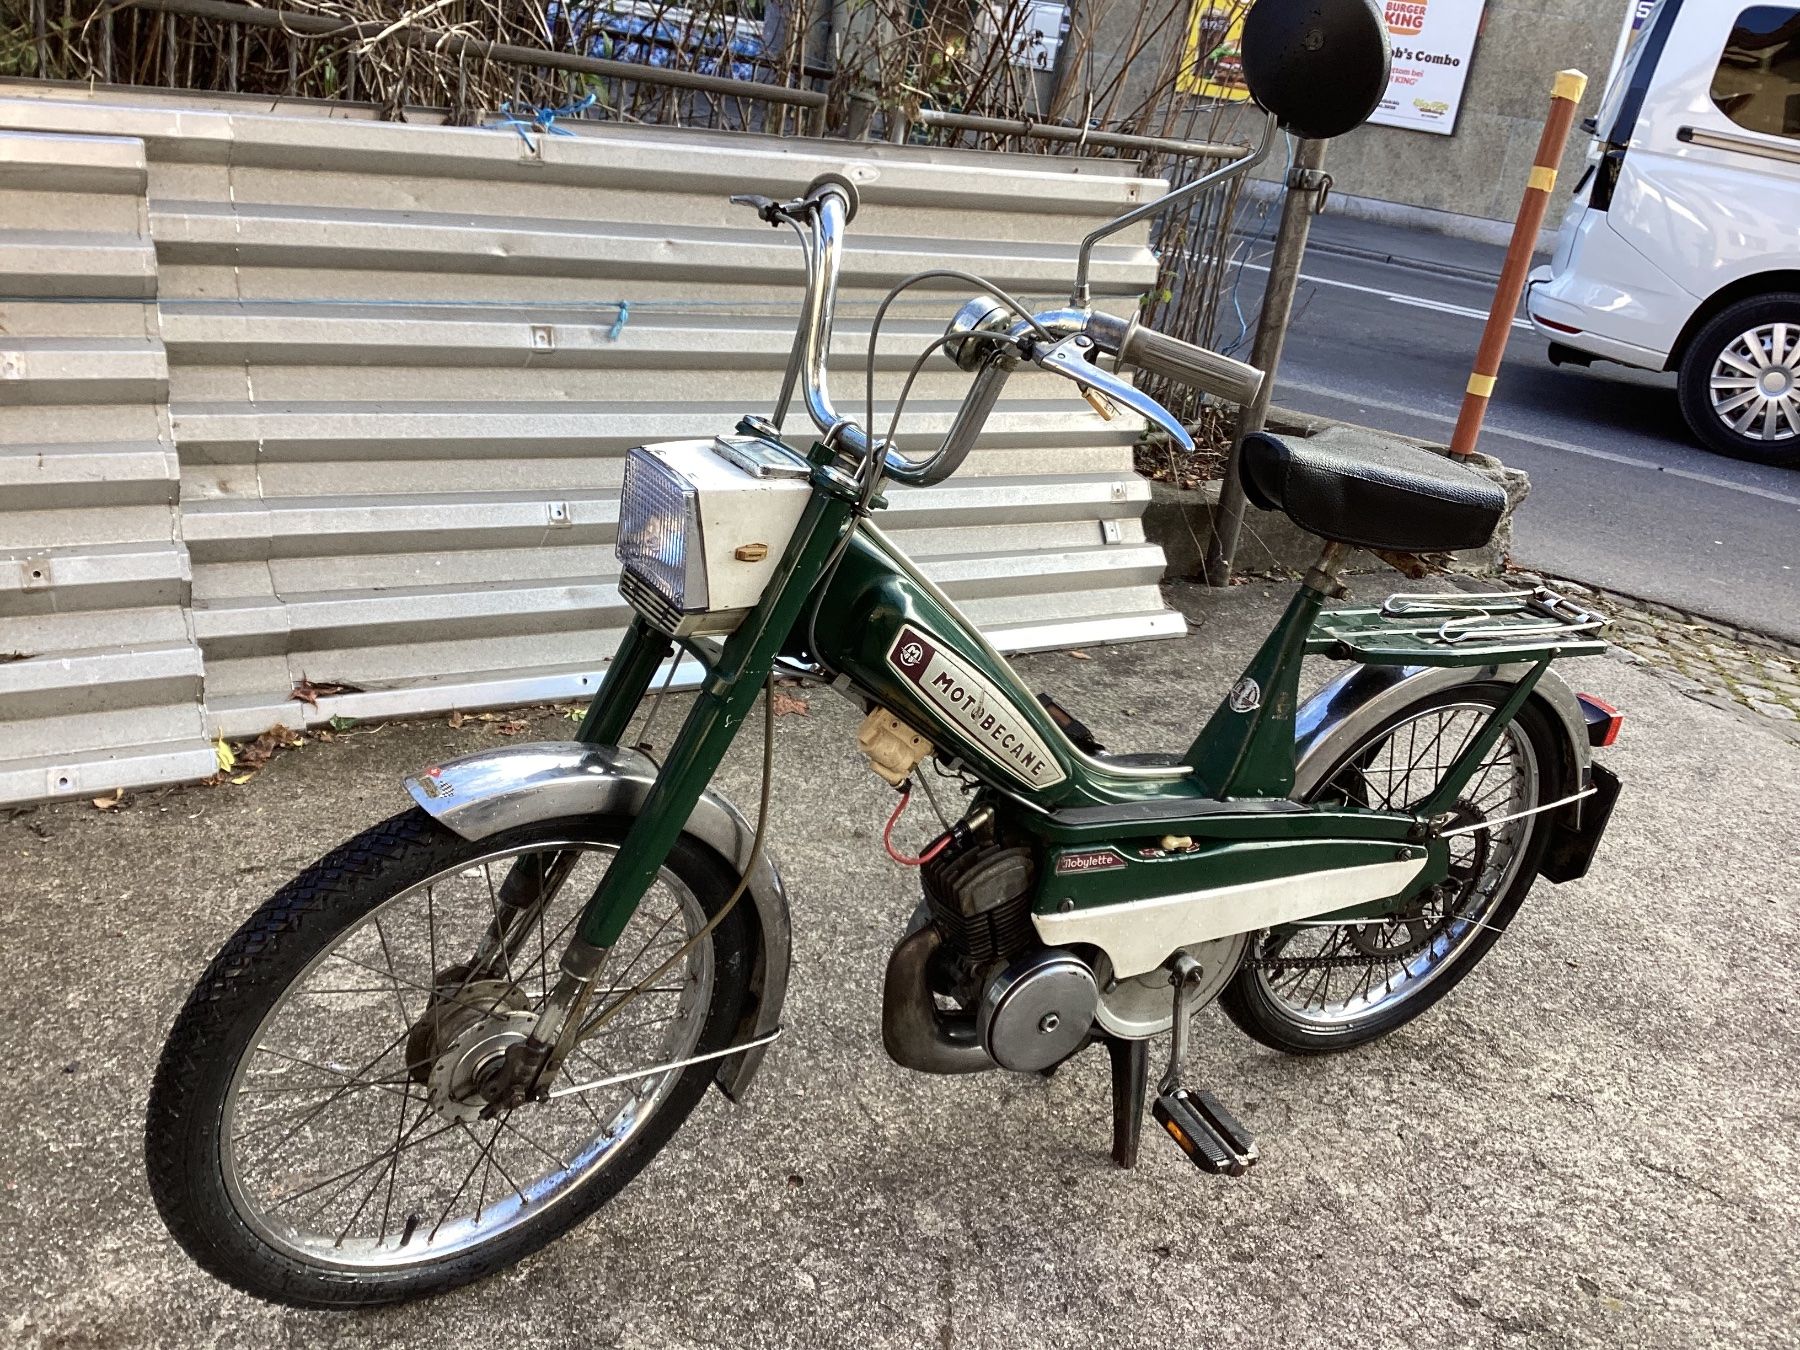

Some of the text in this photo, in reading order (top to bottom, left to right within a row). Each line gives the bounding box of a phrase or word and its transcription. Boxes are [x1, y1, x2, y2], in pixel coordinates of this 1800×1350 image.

[1386, 2, 1426, 15] BURGER
[1385, 11, 1424, 28] KING
[1416, 51, 1461, 67] Combo
[931, 671, 1046, 776] MOTOBECANE
